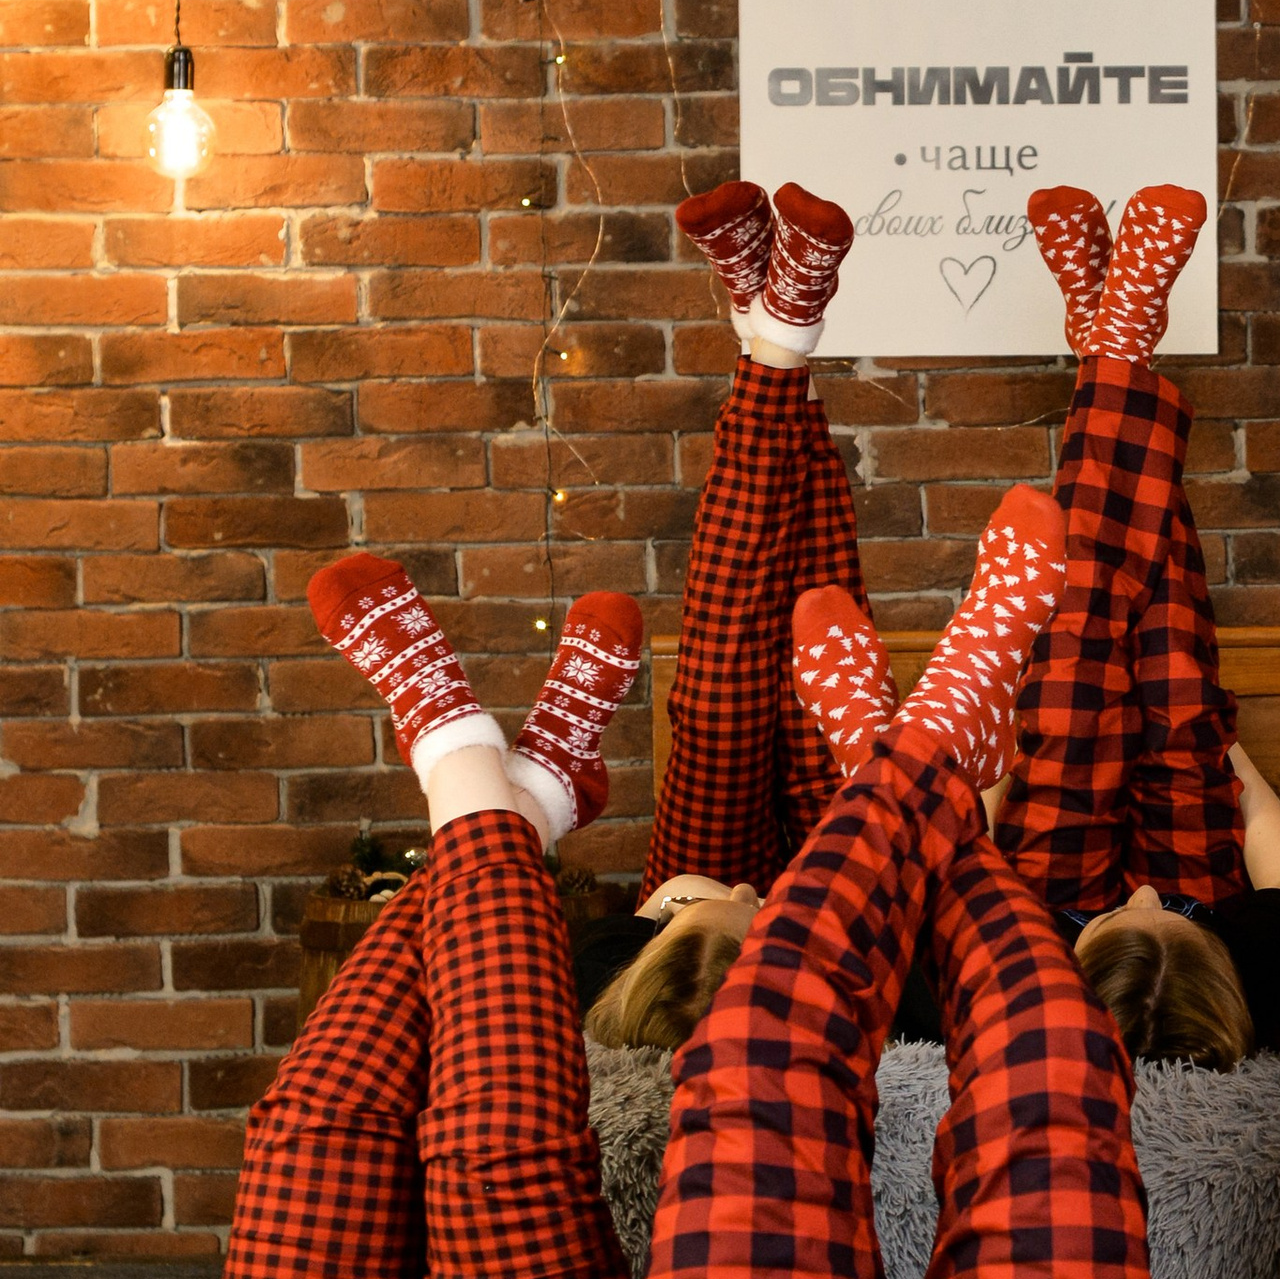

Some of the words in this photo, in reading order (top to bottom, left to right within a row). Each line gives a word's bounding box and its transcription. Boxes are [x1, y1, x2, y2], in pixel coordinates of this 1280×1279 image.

[767, 51, 1190, 107] ОБНИМАЙТЕ
[920, 144, 1039, 177] чаще
[854, 189, 943, 237] своих
